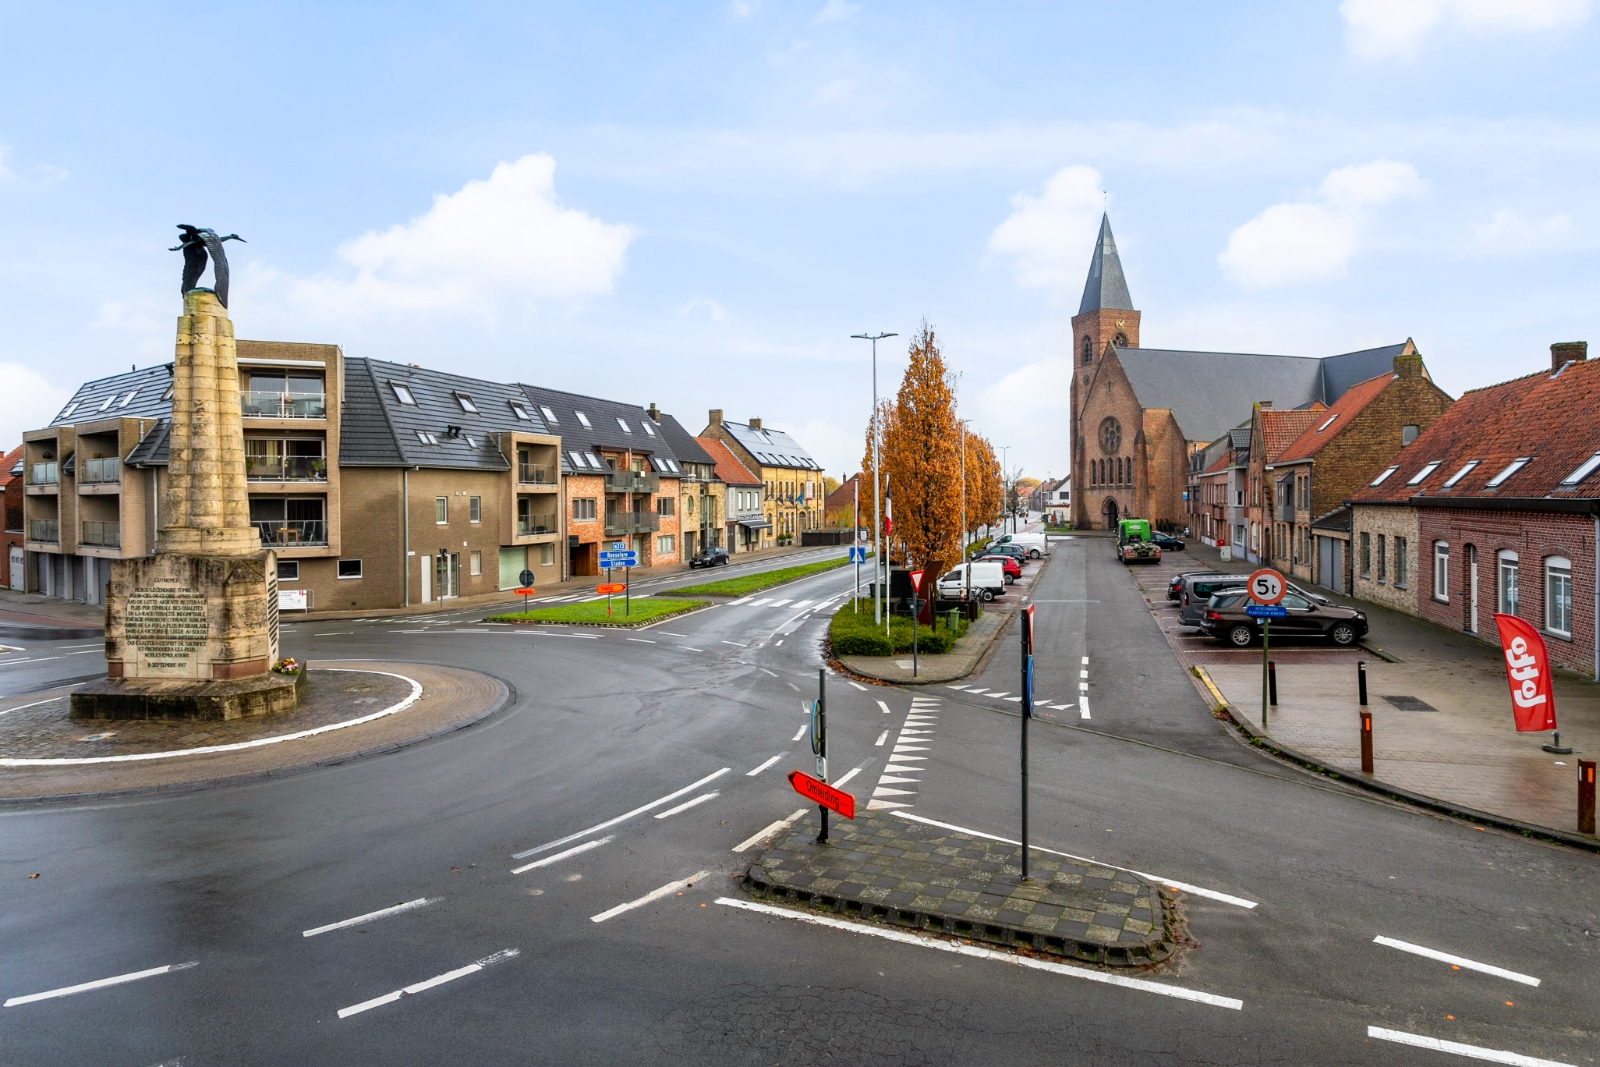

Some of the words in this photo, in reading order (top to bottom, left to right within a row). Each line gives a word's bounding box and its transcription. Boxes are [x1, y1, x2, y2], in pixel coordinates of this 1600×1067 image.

[1257, 579, 1269, 596] 5
[1272, 584, 1277, 594] t
[806, 780, 839, 810] Omleiding
